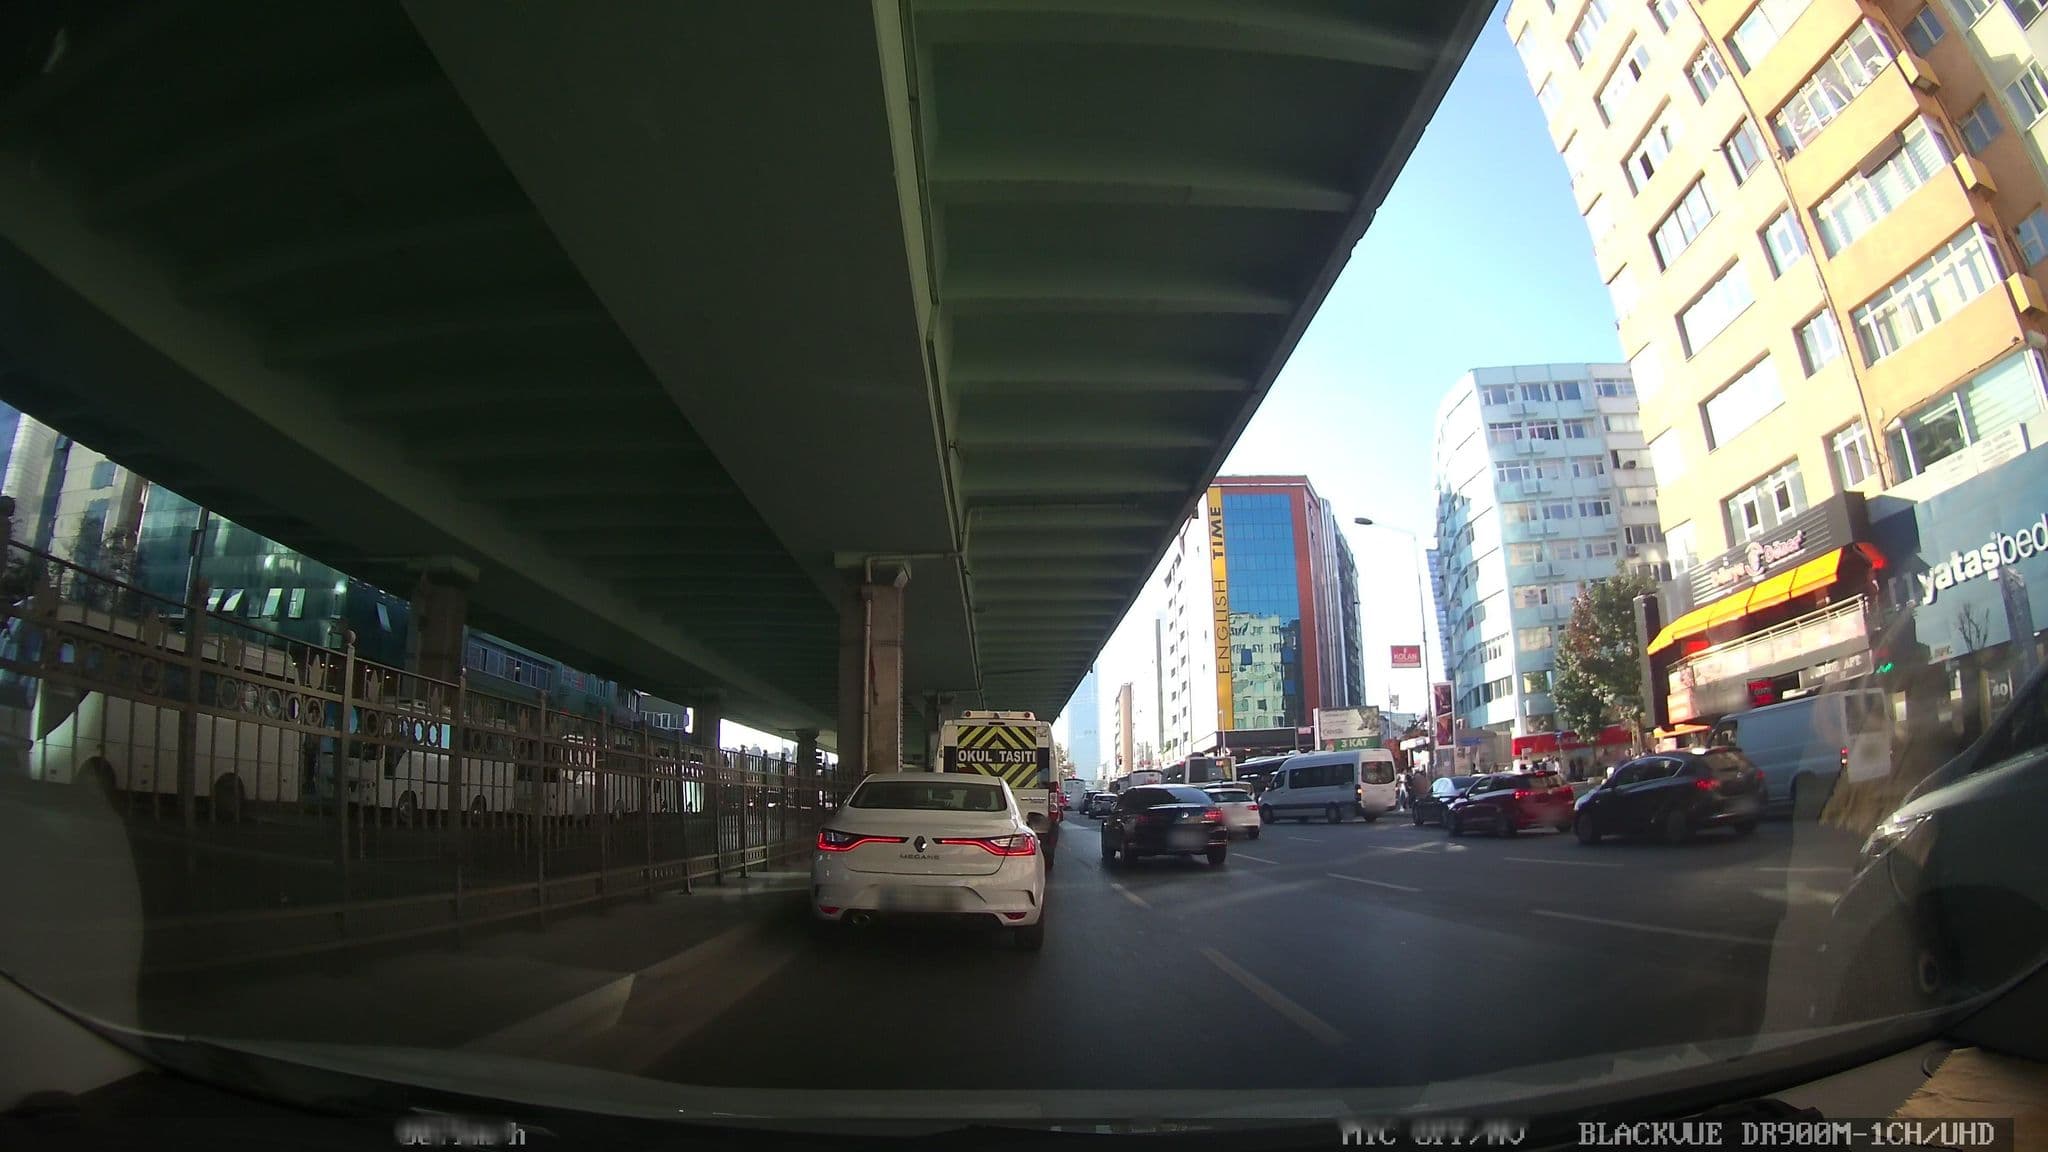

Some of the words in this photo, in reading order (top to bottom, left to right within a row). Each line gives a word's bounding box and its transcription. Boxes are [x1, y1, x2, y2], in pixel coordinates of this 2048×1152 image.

[1210, 506, 1223, 560] TIME
[1214, 579, 1230, 674] ENGLISH
[958, 750, 993, 762] OKUL
[1340, 739, 1347, 748] 3
[1348, 738, 1369, 747] KAT
